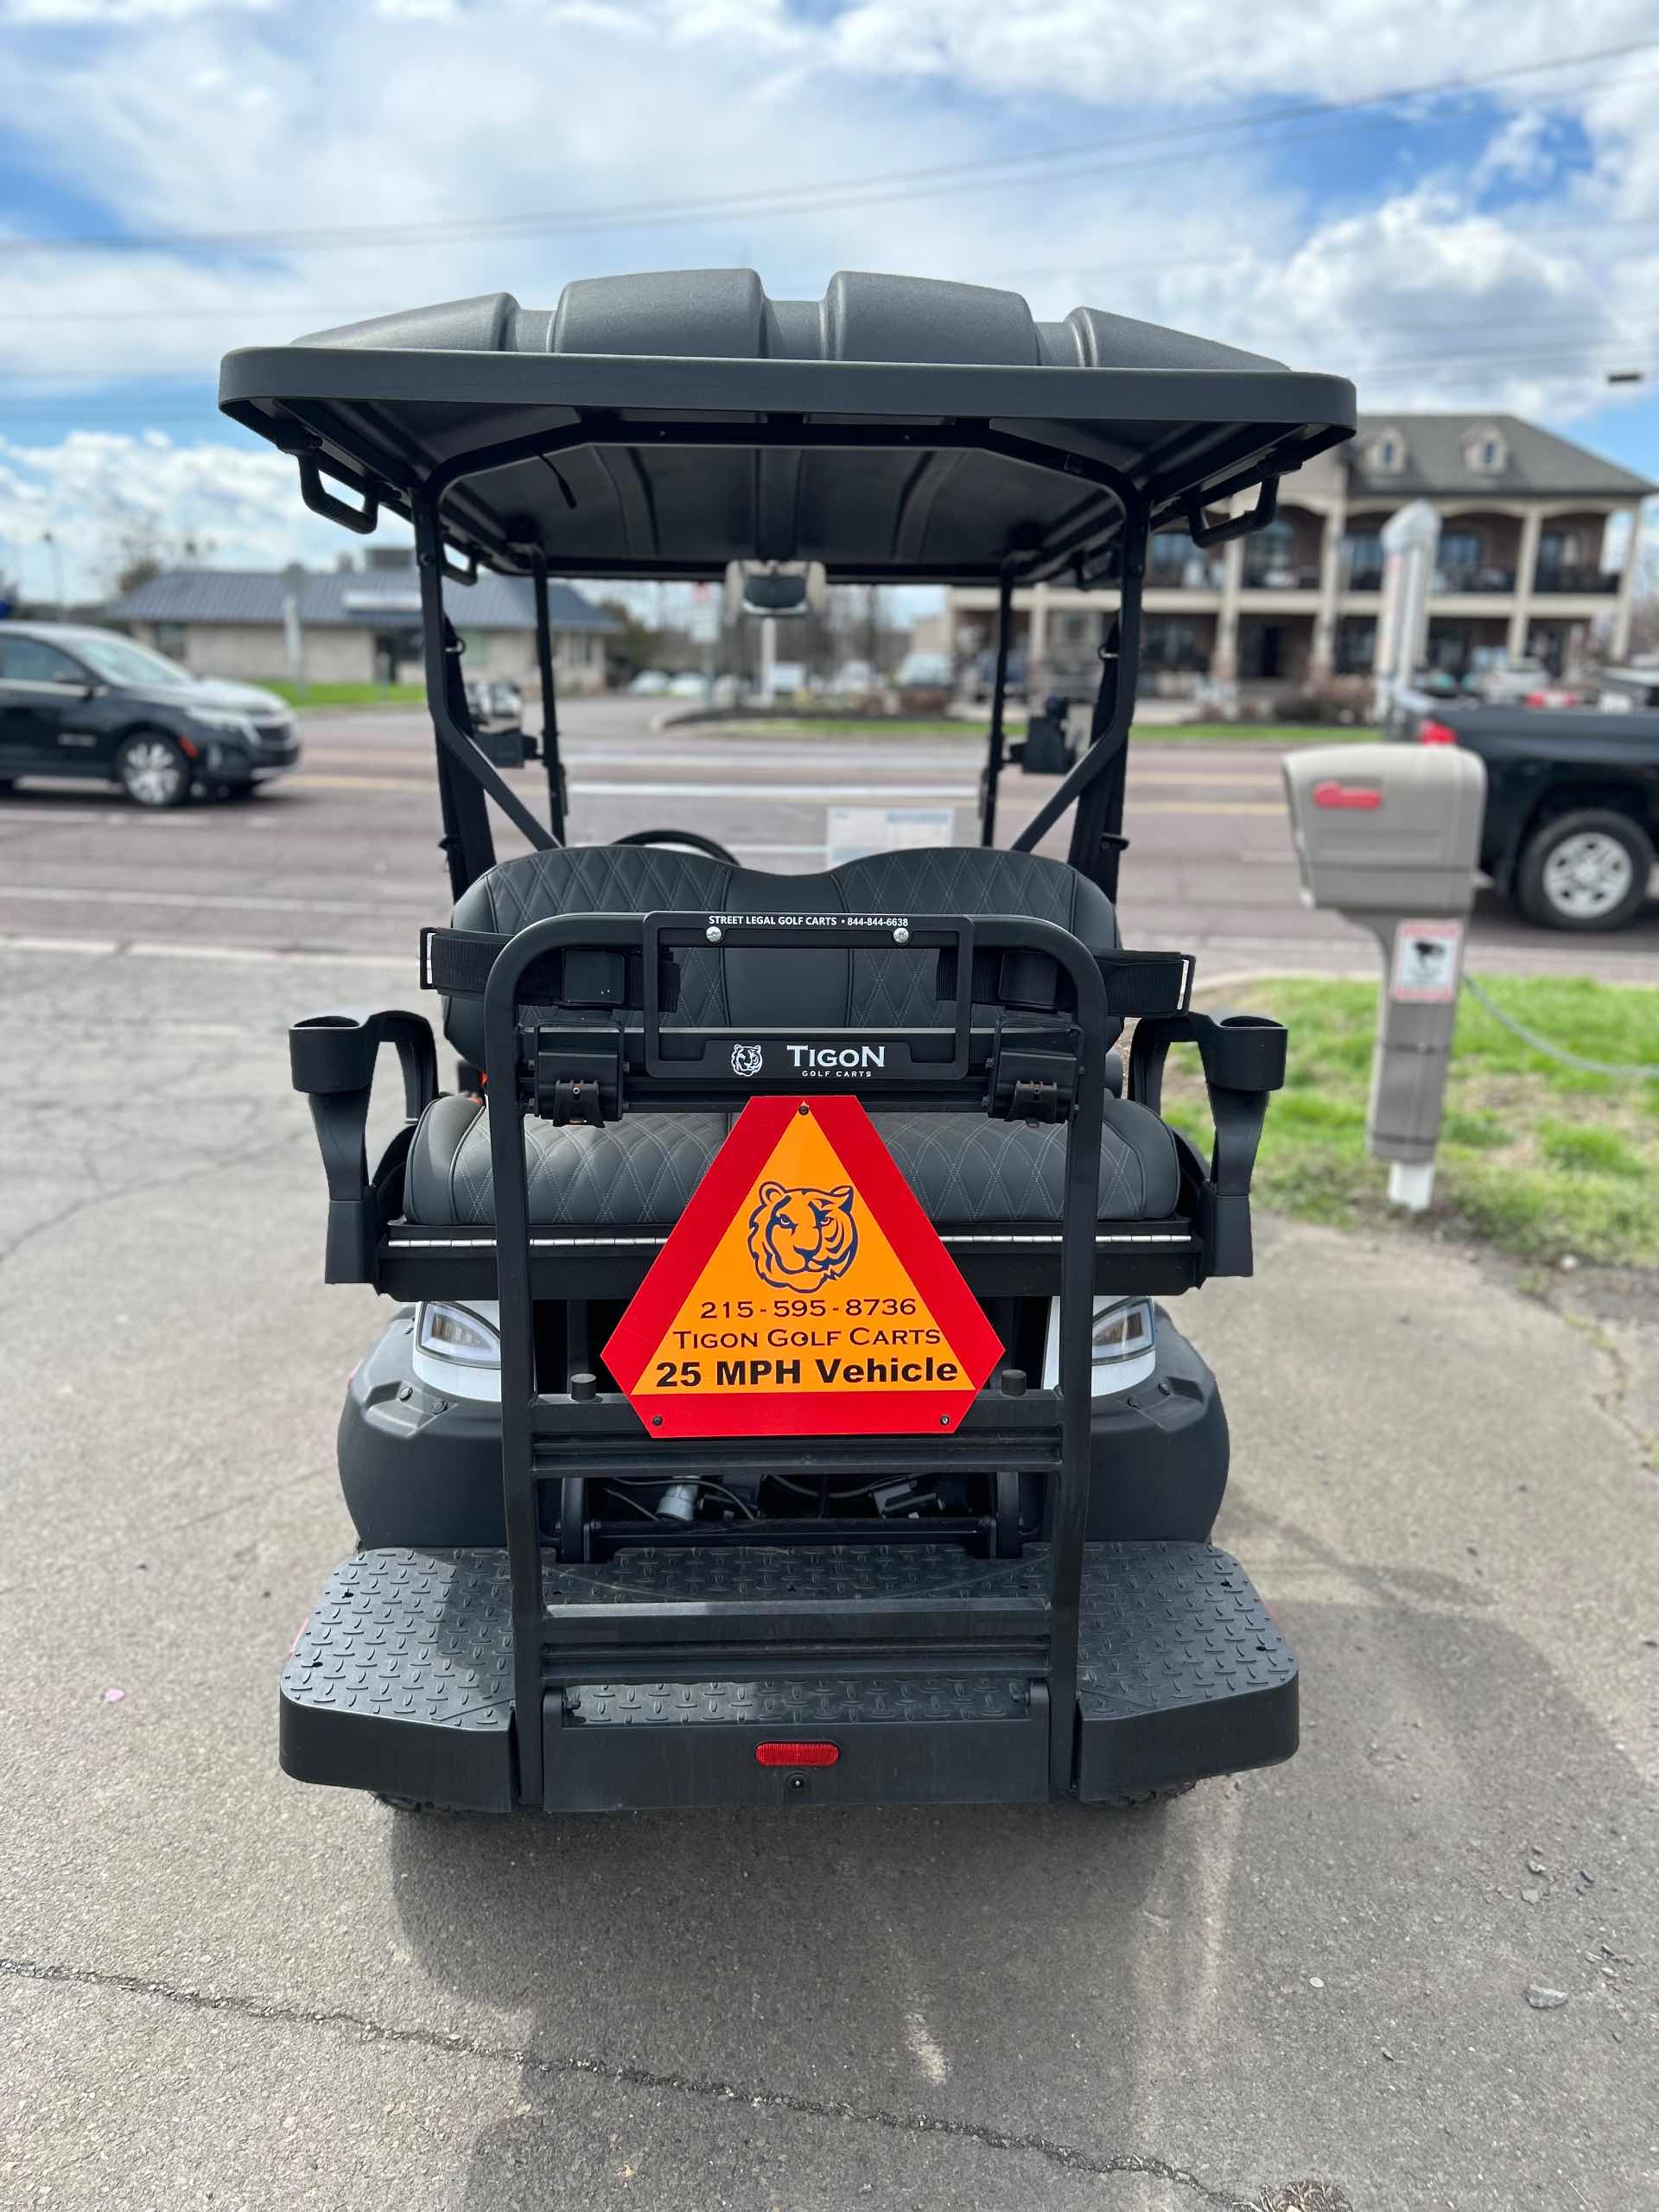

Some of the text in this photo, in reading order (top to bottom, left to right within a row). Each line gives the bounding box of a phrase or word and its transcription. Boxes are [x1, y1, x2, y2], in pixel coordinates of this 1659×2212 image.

[709, 915, 744, 925] STREET
[746, 916, 776, 925] LEGAL
[778, 916, 804, 925] GOLF
[805, 917, 837, 925] CARTS
[848, 918, 908, 927] 844-844-6638
[786, 1045, 886, 1067] TIGON
[673, 1327, 941, 1350] TIGON GOLF CARTS
[656, 1357, 958, 1388] 25 MPH Vehicle
